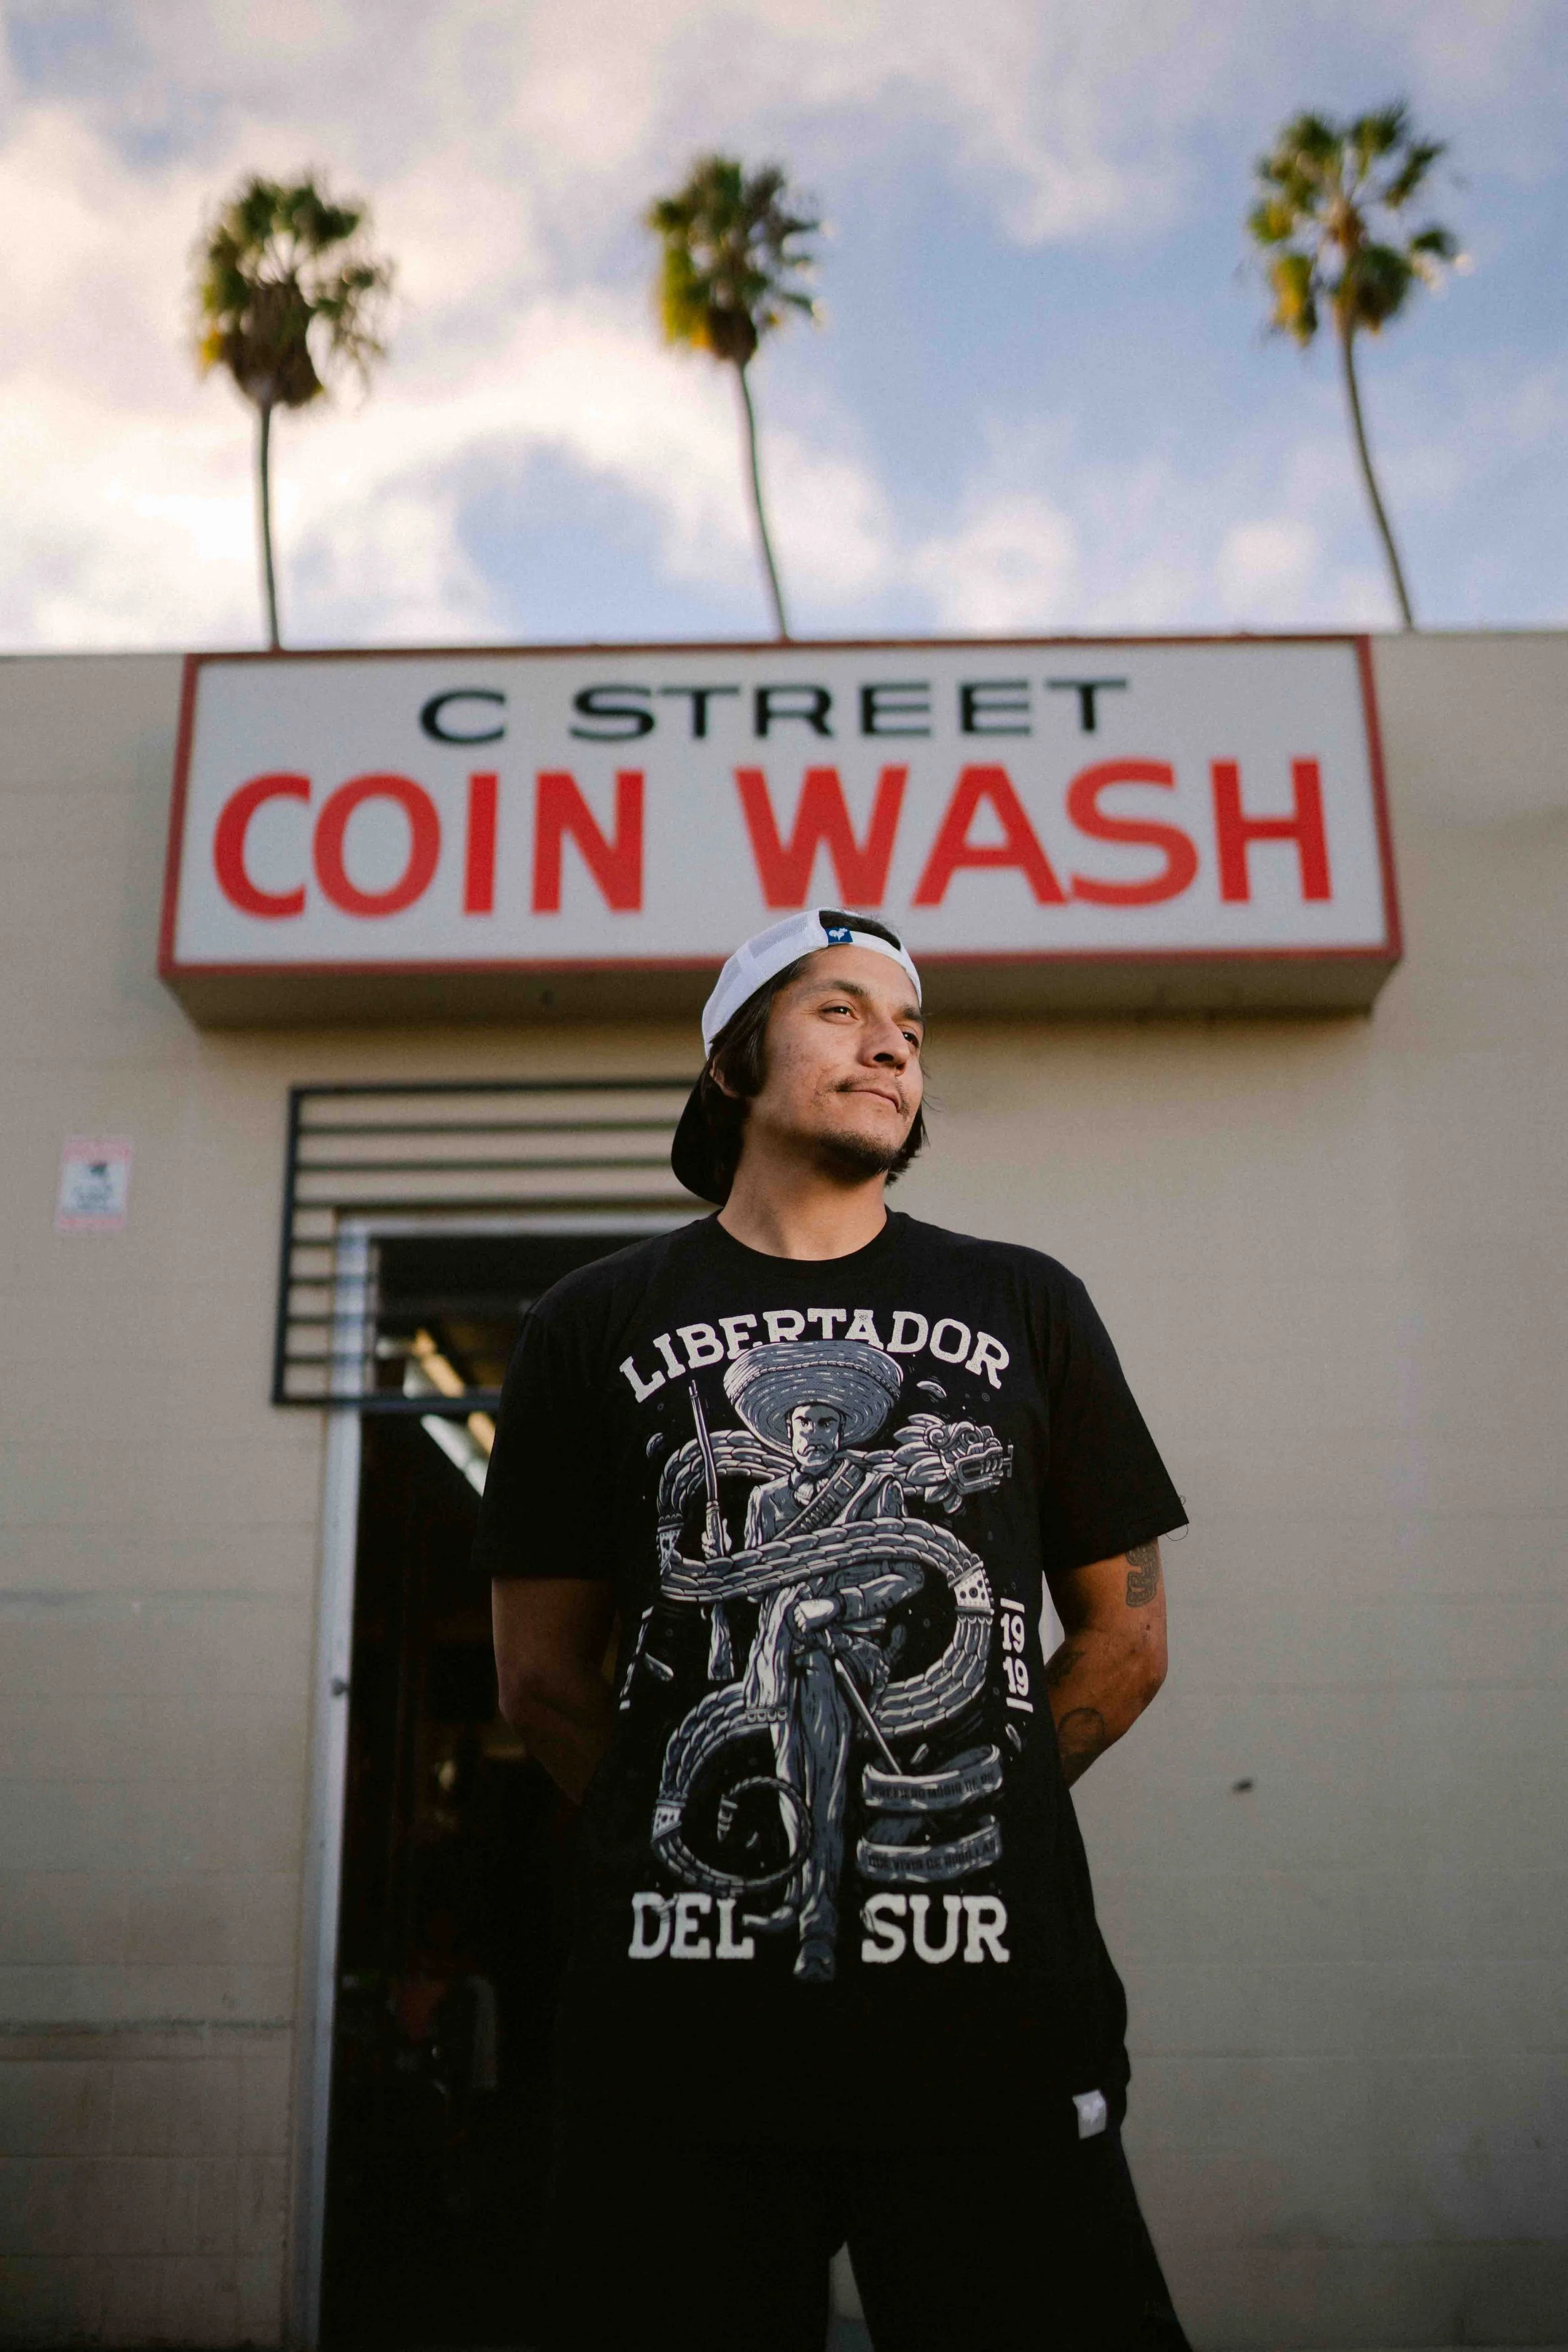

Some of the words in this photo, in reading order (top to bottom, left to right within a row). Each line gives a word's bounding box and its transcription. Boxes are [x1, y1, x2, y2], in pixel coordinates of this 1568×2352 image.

[419, 689, 506, 746] C
[569, 678, 1126, 742] STREET
[213, 769, 645, 919] COIN
[734, 758, 1332, 909] WASH
[619, 1308, 1010, 1403] LIBERTADOR
[628, 1892, 755, 1959] DEL
[862, 1893, 1010, 1963] SUR
